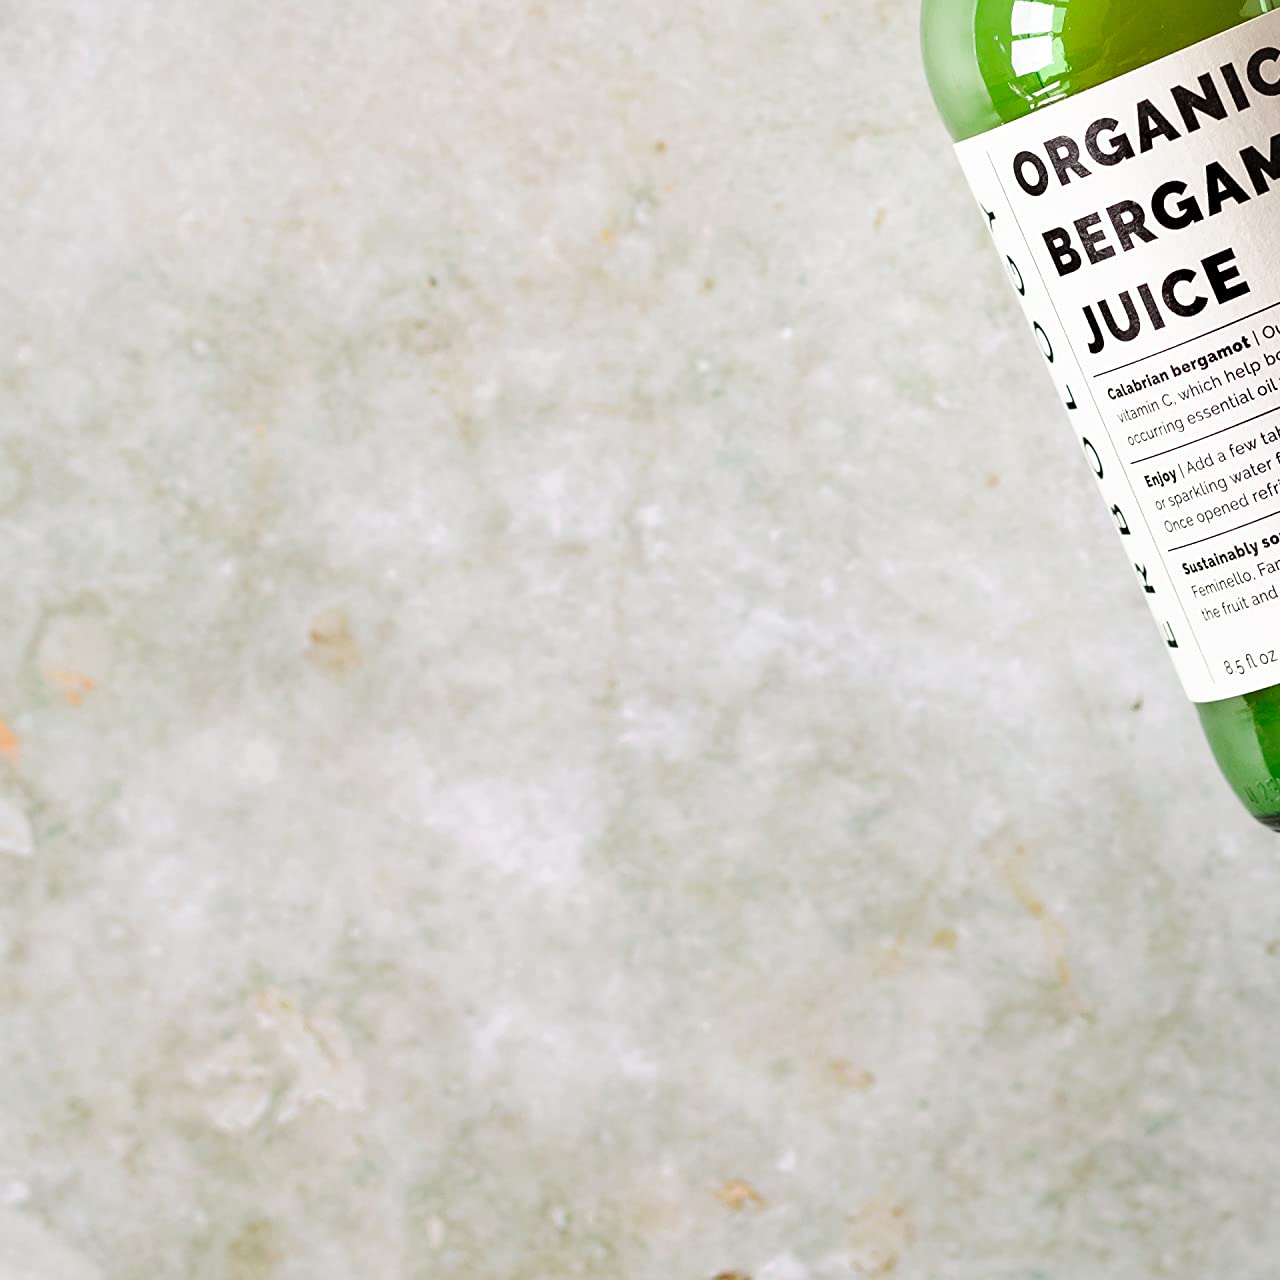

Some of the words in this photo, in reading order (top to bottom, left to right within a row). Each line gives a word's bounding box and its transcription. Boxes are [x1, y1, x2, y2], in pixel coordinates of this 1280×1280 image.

[1082, 247, 1251, 354] JUICE
[1107, 371, 1170, 400] Calabrian
[1169, 335, 1251, 377] bergamot
[1117, 401, 1160, 424] vitamin
[1161, 393, 1177, 407] C,
[1177, 375, 1223, 400] which
[1223, 361, 1261, 383] help
[979, 201, 1179, 649] ERBOLOGY
[1127, 418, 1185, 446] occurring
[1186, 387, 1255, 424] essential
[1257, 377, 1278, 396] oil
[1143, 469, 1177, 488] Enjoy
[1187, 452, 1215, 474] Add
[1217, 451, 1227, 463] a
[1228, 438, 1256, 457] few
[1155, 498, 1166, 510] or
[1167, 477, 1228, 508] sparkling
[1228, 459, 1271, 483] water
[1163, 516, 1194, 533] Once
[1196, 492, 1250, 524] opened
[1181, 541, 1259, 575] Sustainably
[1200, 607, 1221, 621] the
[1221, 596, 1249, 615] fruit
[1251, 584, 1279, 606] and
[1245, 653, 1258, 669] fl
[1259, 649, 1278, 665] oz
